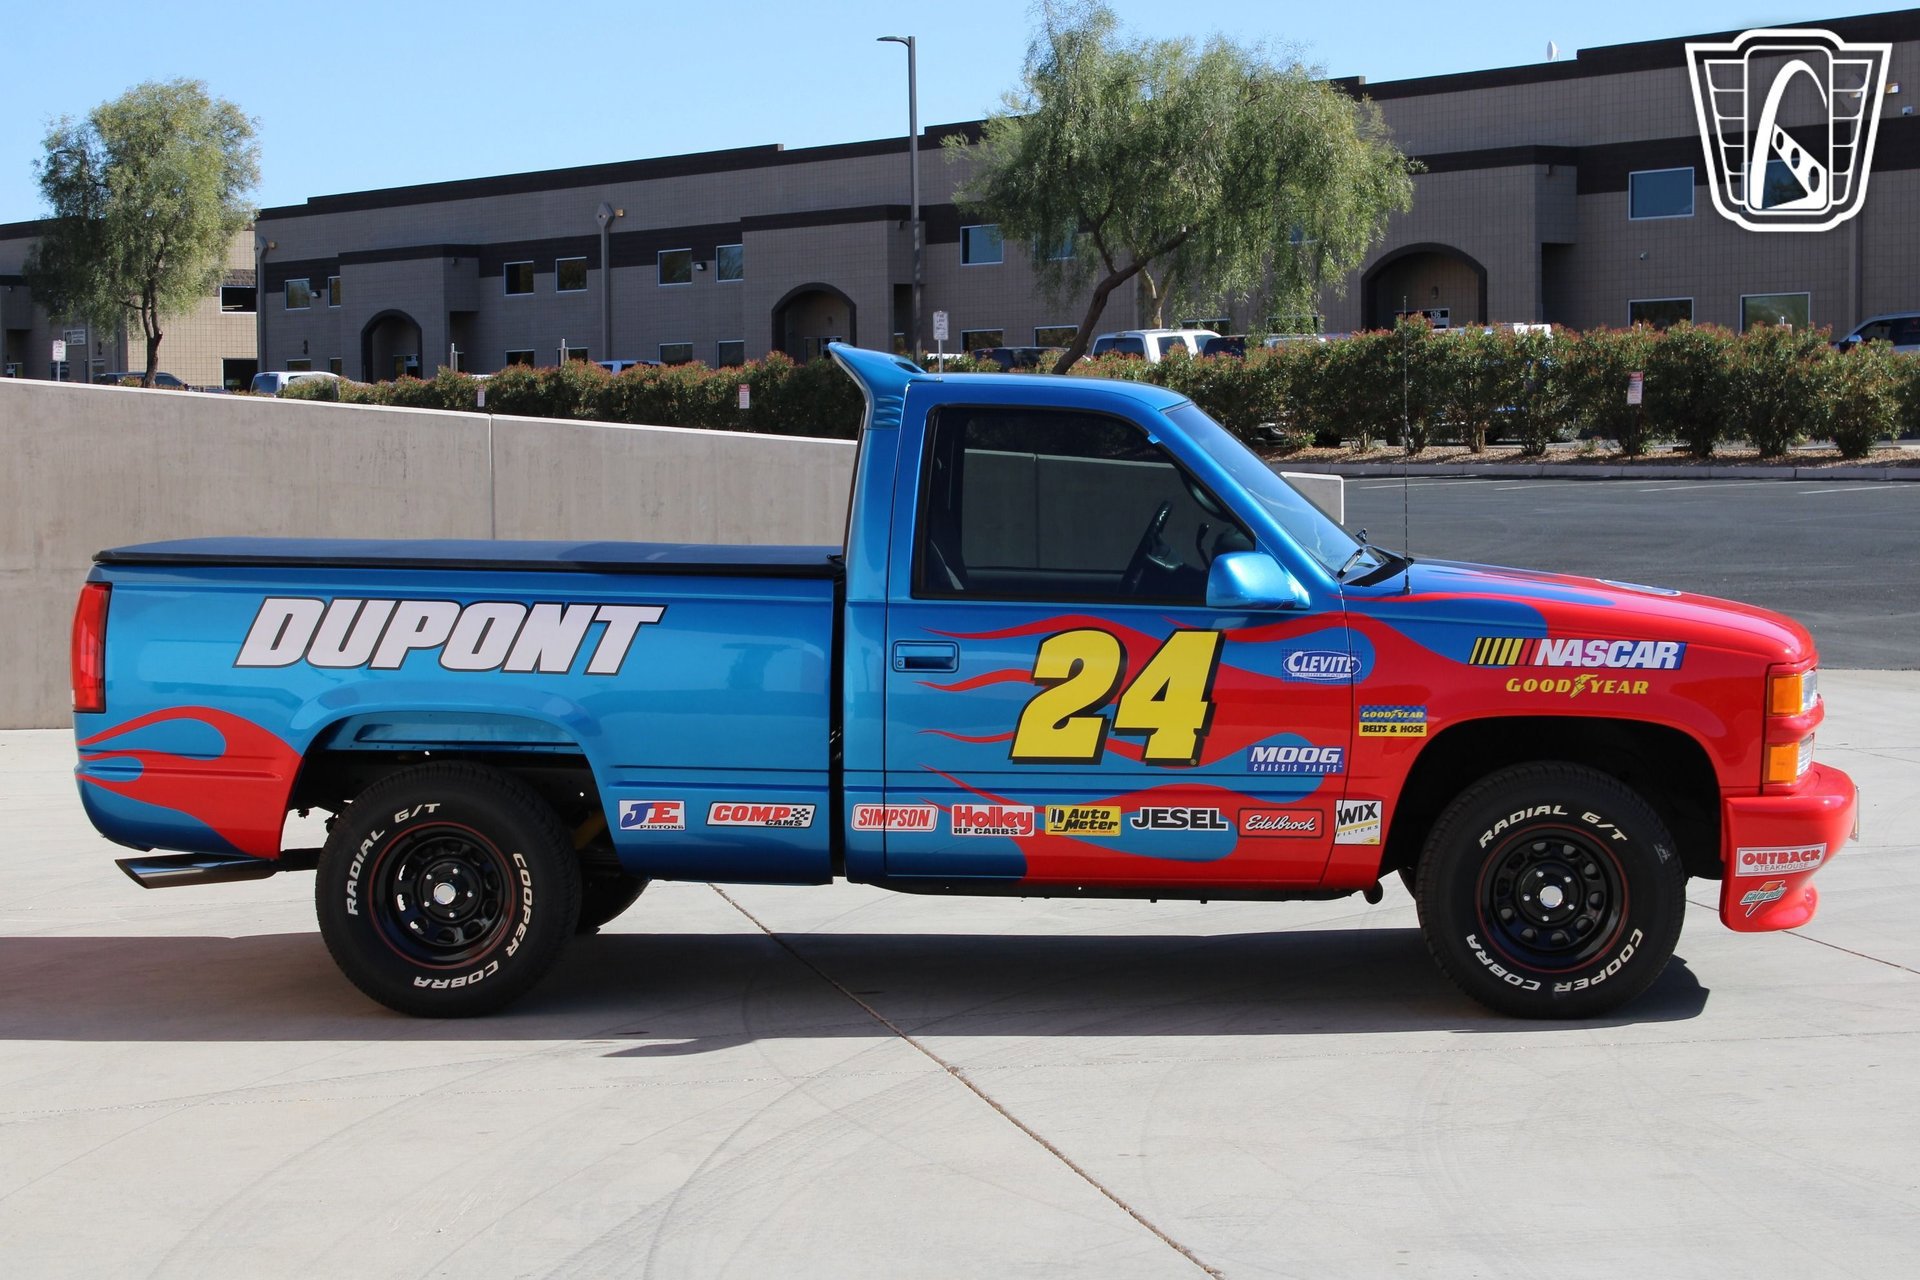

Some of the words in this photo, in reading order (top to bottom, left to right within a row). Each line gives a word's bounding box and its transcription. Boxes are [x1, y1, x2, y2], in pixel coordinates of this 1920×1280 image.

[232, 597, 669, 675] DUPONT
[1535, 638, 1681, 669] NASCAR
[1008, 626, 1221, 766] 24
[1362, 724, 1388, 733] BELTS
[1389, 724, 1398, 733] &
[1400, 725, 1424, 734] HOSE
[1250, 746, 1342, 763] MOOG
[1253, 763, 1298, 772] CHASSIS
[1305, 764, 1338, 773] PARTS
[621, 802, 680, 828] JE
[713, 805, 791, 822] COMP
[765, 819, 803, 827] CAMS
[858, 807, 931, 827] SIMPSON
[953, 805, 1033, 835] Holley
[1068, 808, 1111, 820] Auto
[1131, 807, 1228, 830] JESEL
[1245, 814, 1317, 832] Edelbrock
[1337, 802, 1378, 826] WIX
[974, 827, 1019, 835] CARBS
[1063, 819, 1119, 832] Meter
[1336, 824, 1379, 838] FILTERS
[1478, 804, 1569, 849] RADIAL
[1581, 811, 1628, 842] G/T
[346, 829, 386, 916] RADIAL
[394, 802, 441, 824] G/T
[1742, 849, 1821, 866] OUTBACK
[1753, 862, 1809, 872] STEAKHOUSE
[504, 852, 533, 958] COOPER
[1465, 934, 1542, 992] COBRA
[1553, 928, 1644, 993] COOPER
[413, 959, 500, 989] COBRA
